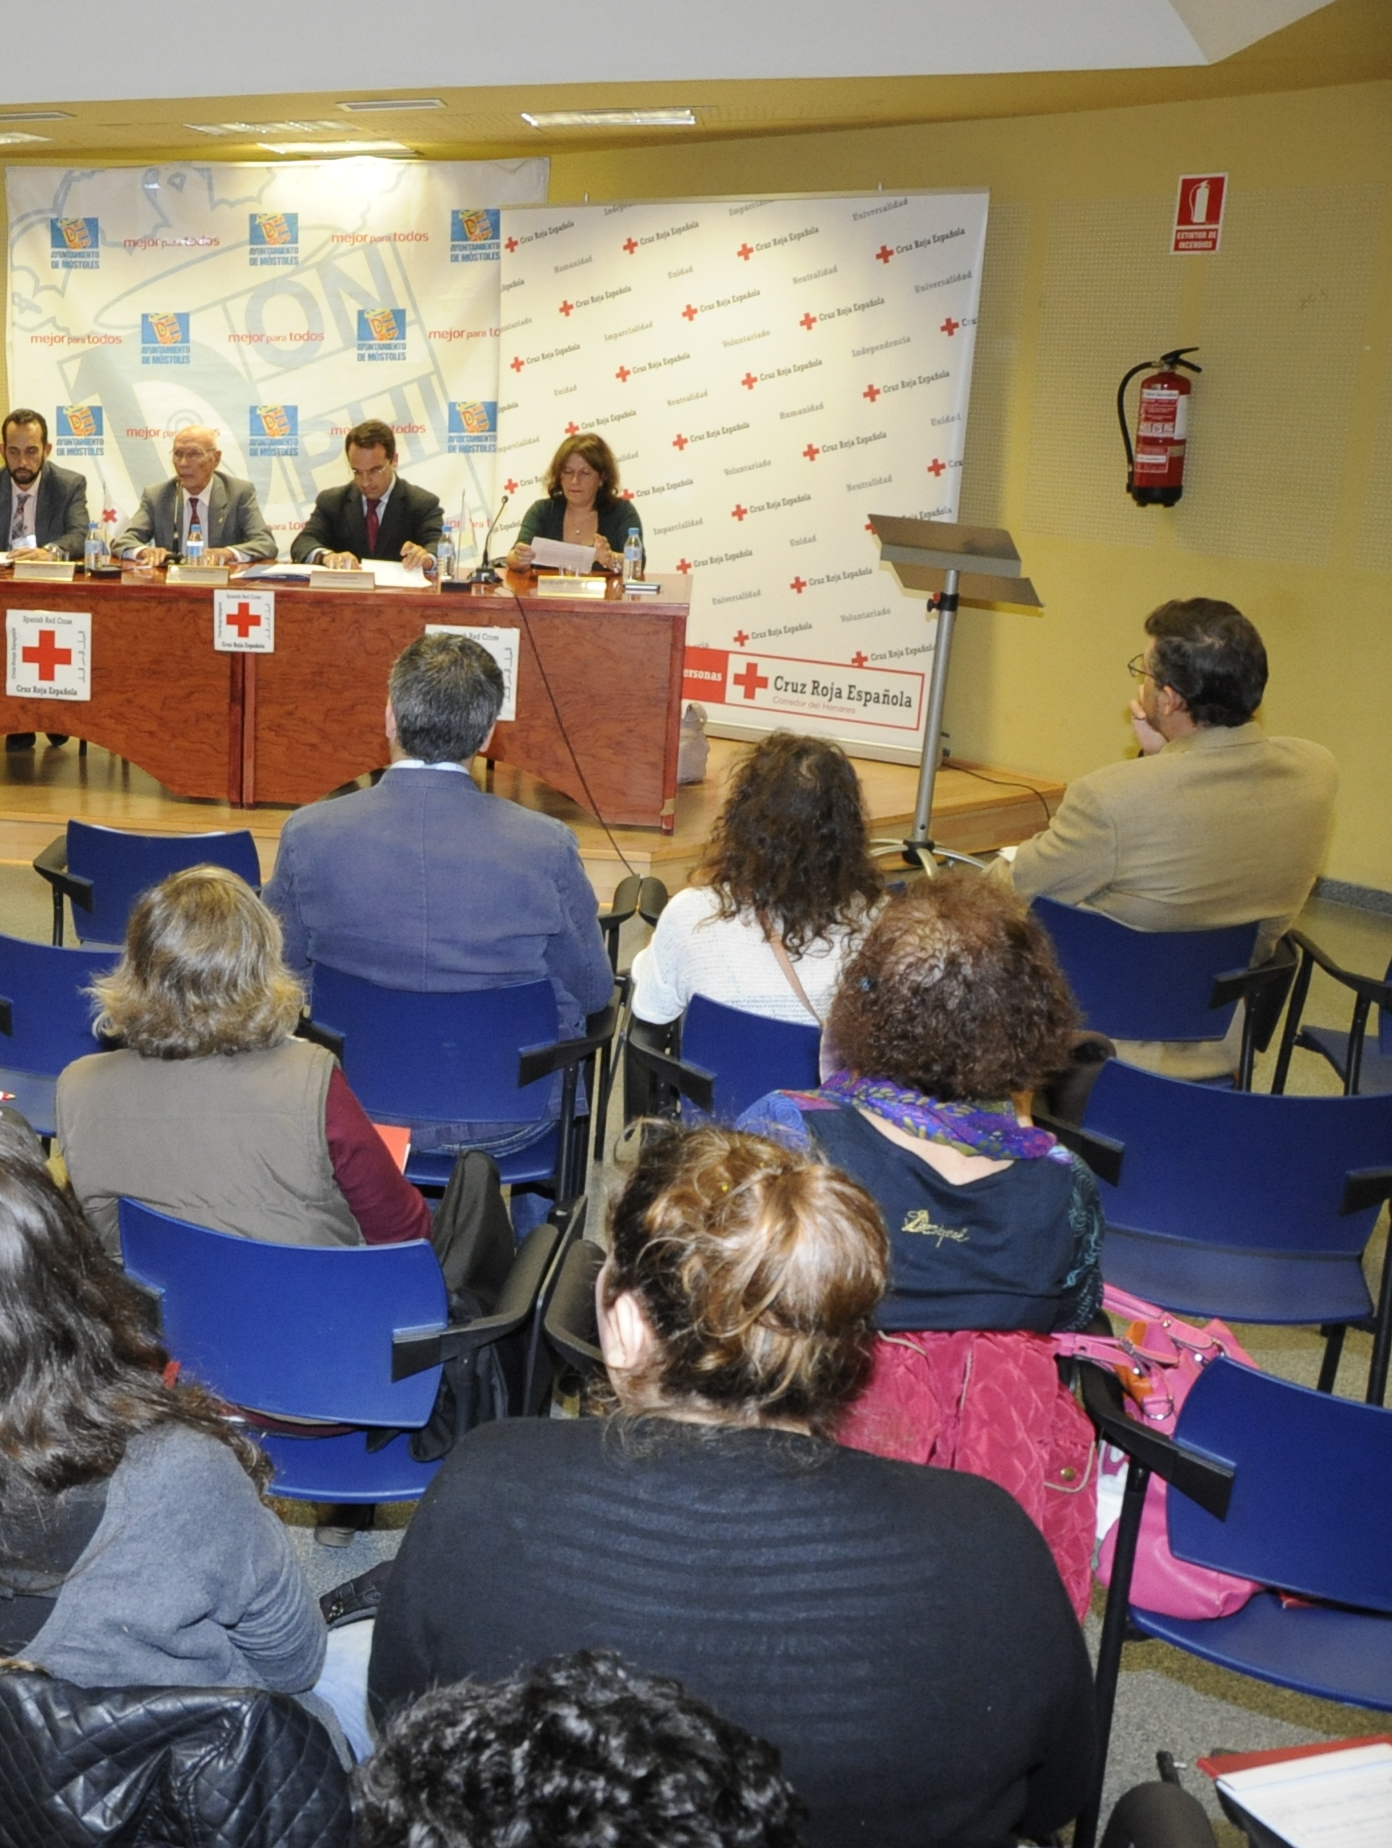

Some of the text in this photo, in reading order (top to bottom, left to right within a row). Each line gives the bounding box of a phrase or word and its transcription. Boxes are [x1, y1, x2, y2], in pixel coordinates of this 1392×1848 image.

[124, 236, 160, 250] mejor
[183, 236, 220, 246] todos
[331, 232, 429, 246] mejor para todos
[896, 228, 965, 254] Cruz Roja Española
[249, 255, 299, 266] DE MÓSTOLES
[451, 252, 500, 262] DE MÓSTOLES
[51, 260, 60, 269] DE
[30, 334, 122, 346] mejor para todos
[228, 330, 324, 344] mejor para todos
[428, 329, 486, 342] mejor para
[142, 356, 150, 364] DE
[357, 351, 406, 362] DE MÓSTOLES
[883, 371, 950, 393] Cruz Roja Española
[126, 427, 161, 440] mejor
[250, 448, 259, 456] DE
[683, 668, 722, 682] ersonas
[33, 686, 47, 695] Roja
[774, 676, 912, 709] Cruz Roja Española
[773, 696, 856, 714] Corredor del Henares
